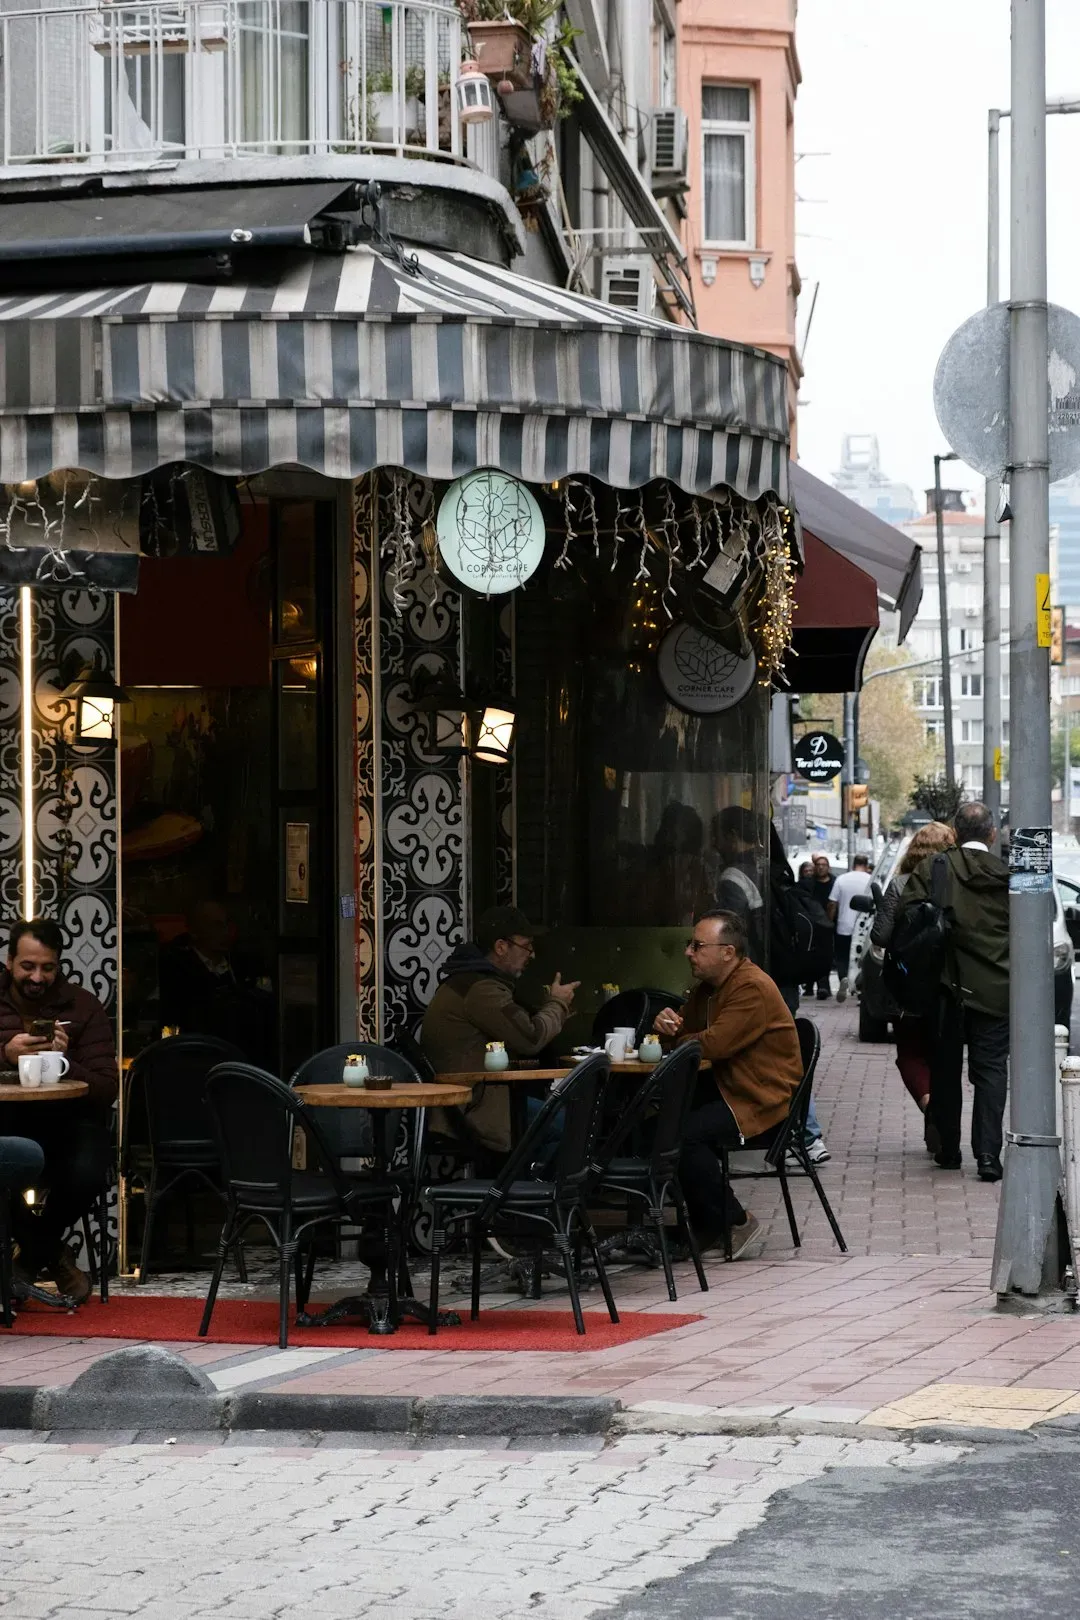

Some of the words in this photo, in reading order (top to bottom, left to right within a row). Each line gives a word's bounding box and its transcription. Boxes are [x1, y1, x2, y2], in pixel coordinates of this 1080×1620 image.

[466, 564, 503, 572] CORR
[506, 564, 528, 572] CAFE
[677, 684, 711, 692] CORNER
[714, 685, 735, 693] CAFE
